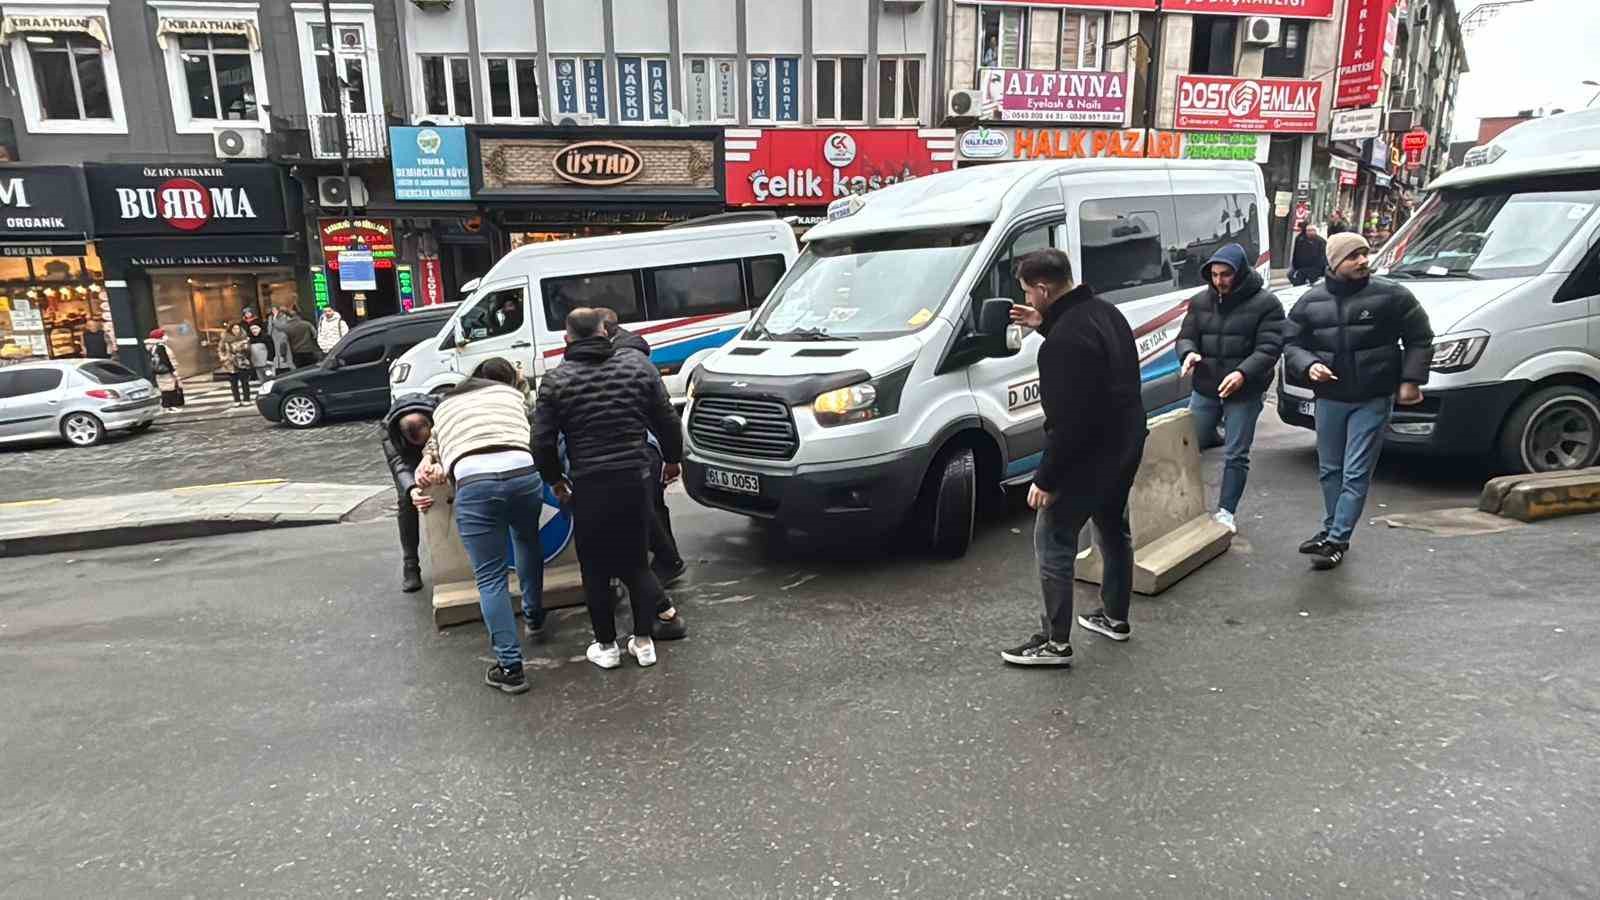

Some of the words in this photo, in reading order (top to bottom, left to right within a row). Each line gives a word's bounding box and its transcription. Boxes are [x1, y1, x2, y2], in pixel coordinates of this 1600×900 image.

[624, 63, 638, 118] KASKO
[652, 67, 664, 115] DASK
[1006, 72, 1123, 98] ALFINNA
[1180, 81, 1232, 109] DOST
[1260, 85, 1319, 112] EMLAK
[1027, 98, 1064, 110] Eyelash
[1066, 99, 1075, 109] &
[1077, 100, 1102, 110] Nails
[1014, 128, 1090, 159] HALK
[1090, 129, 1181, 159] PAZARI
[143, 167, 158, 177] ÖZ
[566, 150, 635, 174] ÜSTAD
[752, 167, 824, 202] çelik
[6, 217, 65, 228] ORGANİK
[1139, 329, 1169, 353] MEYDAN
[1008, 390, 1018, 406] D
[709, 470, 719, 484] 61
[721, 472, 729, 485] D
[731, 474, 758, 490] 0053
